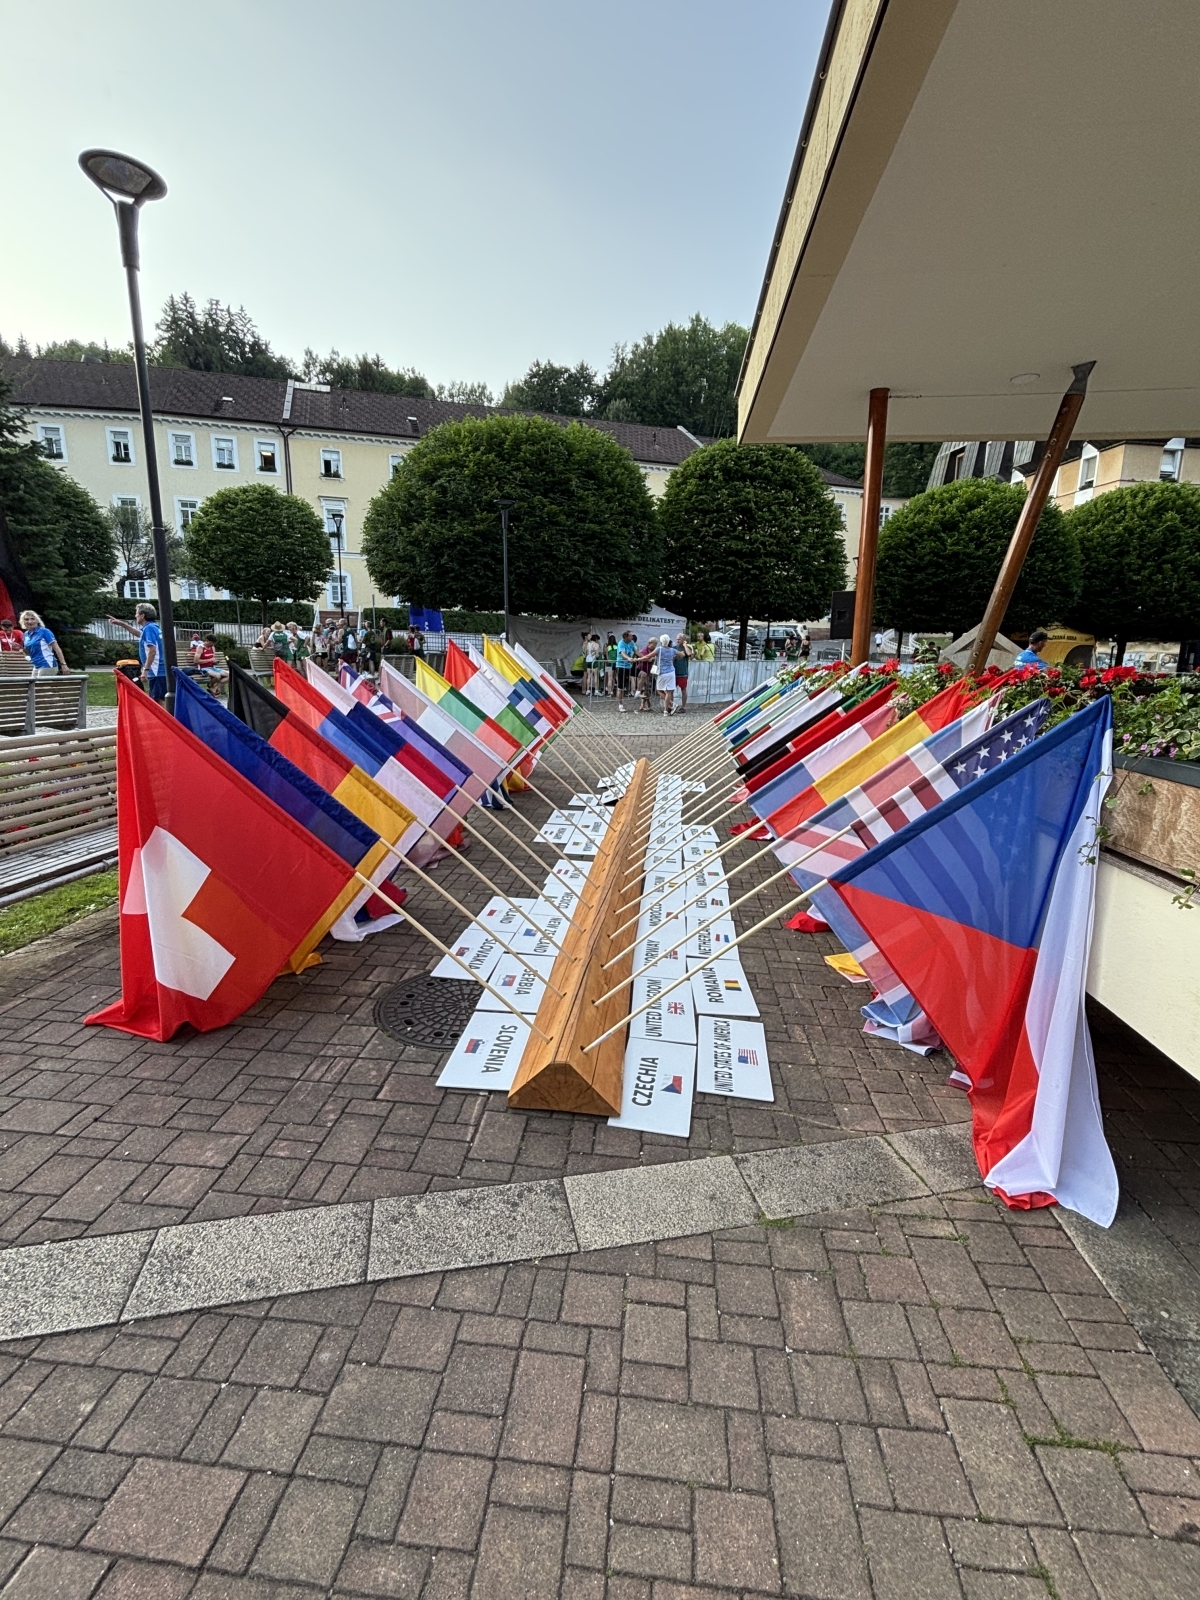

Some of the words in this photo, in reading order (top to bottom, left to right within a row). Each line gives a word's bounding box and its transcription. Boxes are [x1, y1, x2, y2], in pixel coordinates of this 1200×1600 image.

[638, 616, 675, 624] DELIKATESY
[500, 905, 522, 924] OLAND
[546, 916, 563, 930] NEW
[702, 967, 724, 1004] ROMANIA
[645, 1010, 662, 1038] UNITED
[713, 1020, 731, 1042] AMERICA
[481, 1024, 518, 1073] SLOVENIA
[713, 1042, 732, 1051] OF
[713, 1051, 733, 1071] STATES
[632, 1057, 659, 1107] CZECHIA
[714, 1071, 734, 1093] UNITED
